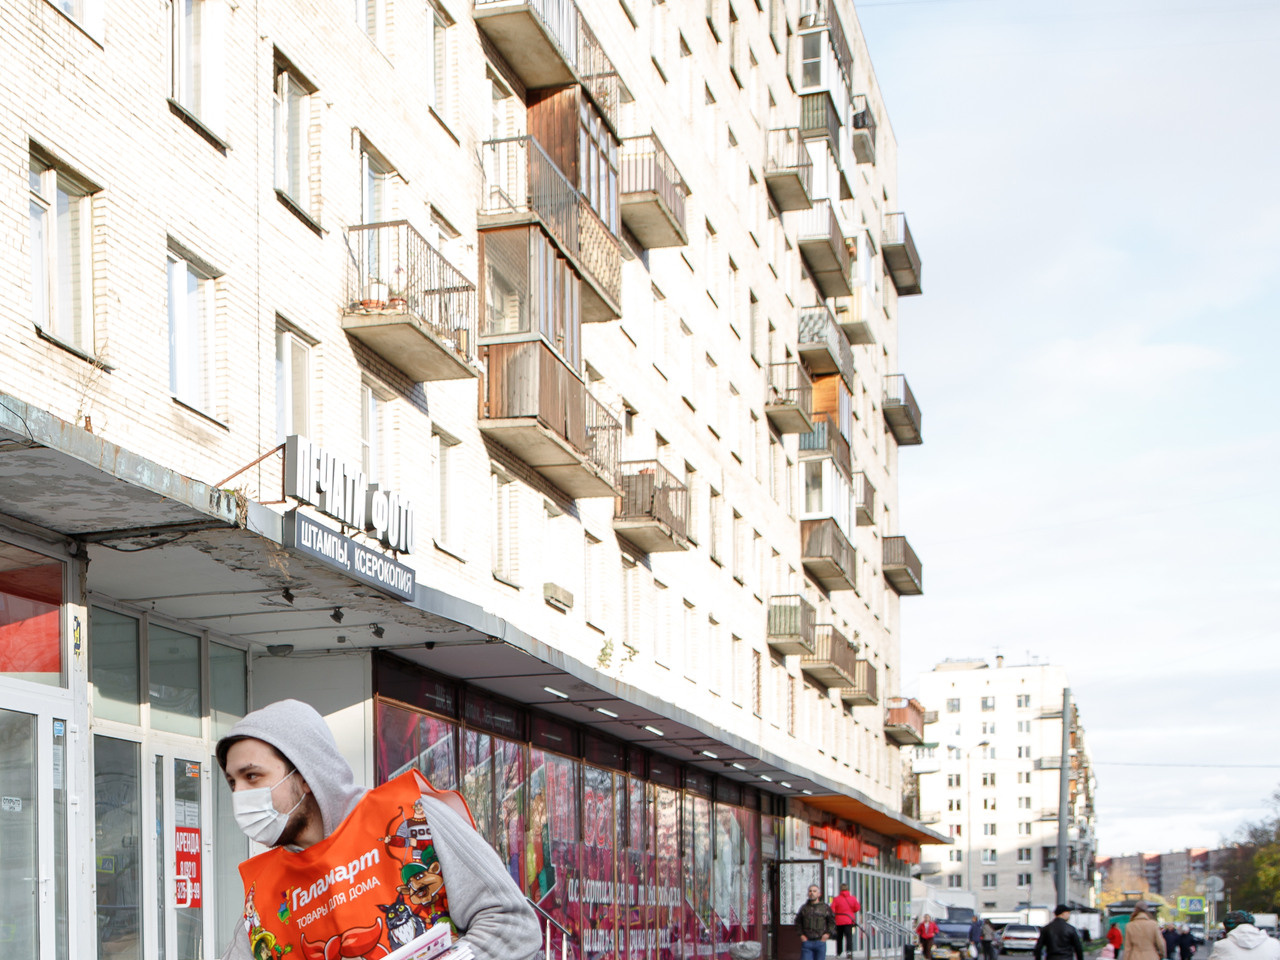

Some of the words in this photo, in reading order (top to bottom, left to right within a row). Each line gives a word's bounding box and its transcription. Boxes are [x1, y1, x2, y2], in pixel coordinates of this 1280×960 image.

[294, 435, 367, 530] ПЕЧАТИ
[371, 483, 415, 555] ФОТО
[301, 520, 351, 570] ШТАМПЫ,
[355, 547, 412, 595] КСЕРОКОПИЯ
[176, 832, 200, 855] АРЕНДА
[292, 848, 380, 911] Галамарт
[296, 904, 328, 929] ТОВАРЫ
[329, 892, 346, 912] ДЛЯ
[348, 876, 380, 901] ДОМА
